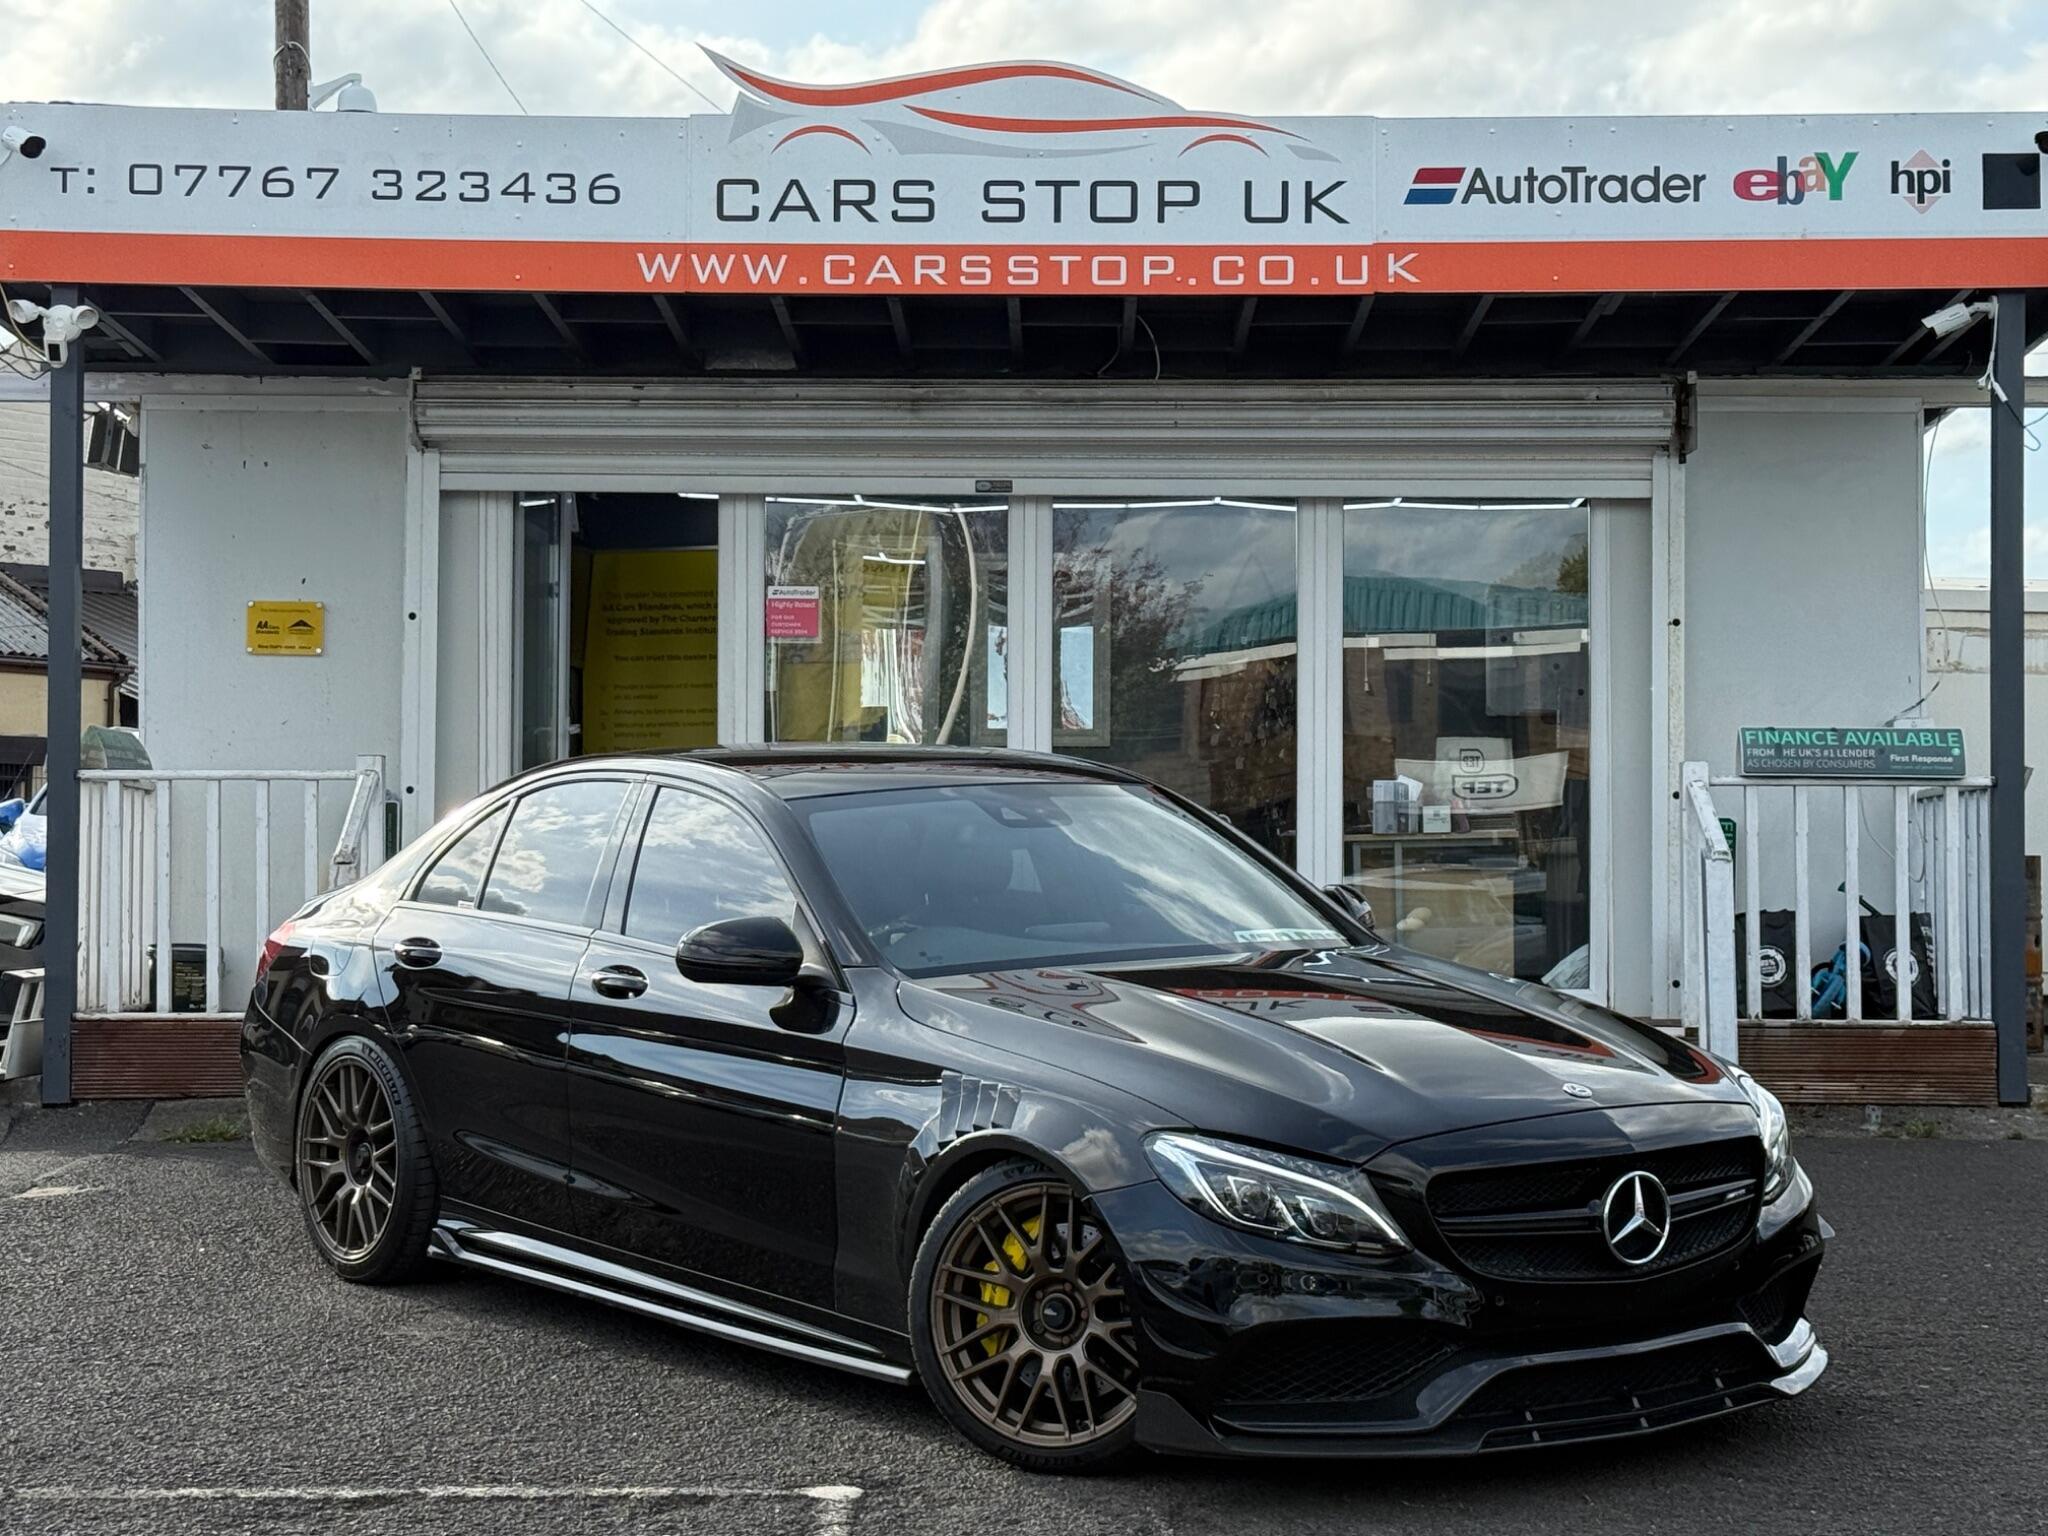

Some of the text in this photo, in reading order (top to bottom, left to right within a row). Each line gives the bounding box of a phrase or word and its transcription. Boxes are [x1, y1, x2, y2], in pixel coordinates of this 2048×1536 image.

[49, 163, 622, 205] T: 07767 323436
[1461, 165, 1707, 205] AutoTrader
[1890, 158, 1951, 205] hpi
[715, 178, 1350, 224] CARS STOP UK
[637, 252, 1420, 287] WWW.CARSSTOP.CO.UK
[1745, 731, 1960, 747] FINANCE AVAILABLE
[1746, 748, 1775, 757] FROM
[1798, 748, 1822, 758] UK'S
[1836, 748, 1876, 758] LENDER
[1746, 758, 1876, 768] AS CHOSEN BY CONSUMERS
[1889, 753, 1954, 764] First Response
